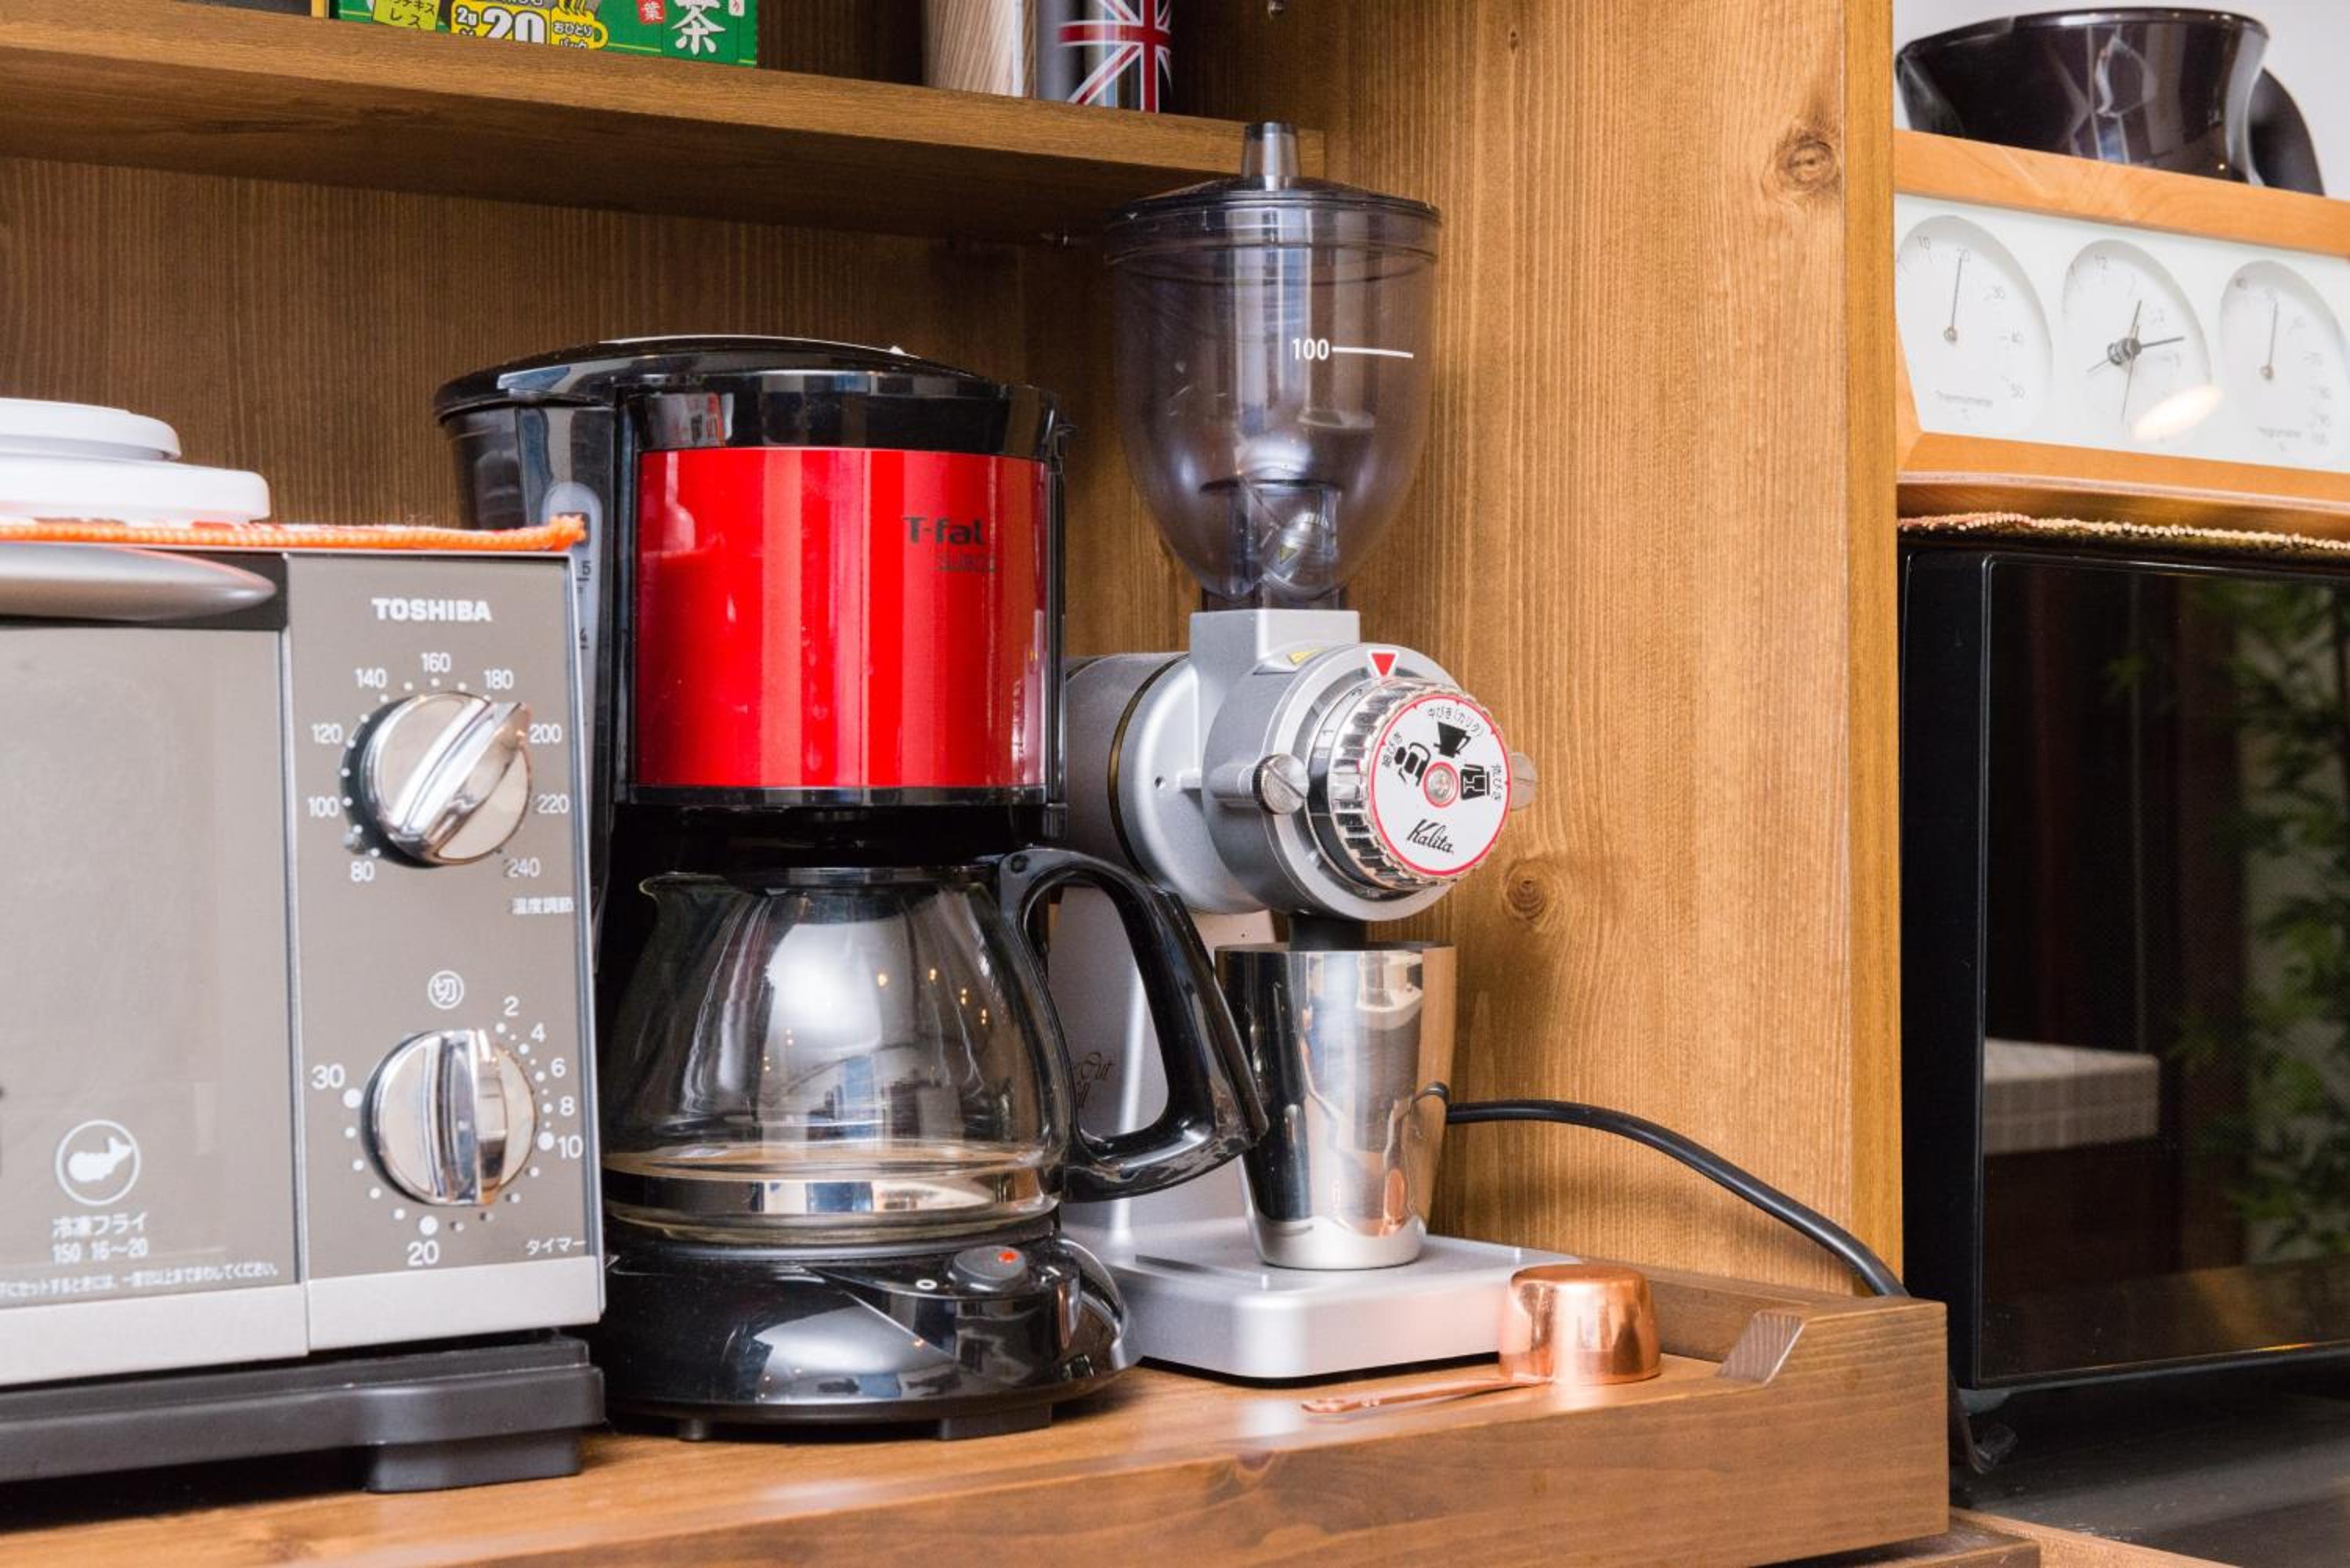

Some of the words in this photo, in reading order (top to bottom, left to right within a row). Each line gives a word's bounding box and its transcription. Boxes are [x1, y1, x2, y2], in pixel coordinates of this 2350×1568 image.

[553, 22, 592, 37] おひとり
[1292, 338, 1329, 361] 100
[902, 516, 984, 545] T-fal
[371, 598, 494, 623] TOSHIBA
[421, 652, 451, 674] 160
[355, 669, 387, 689] 140
[484, 670, 514, 689] 180
[312, 724, 342, 743] 120
[530, 724, 562, 743] 200
[308, 797, 339, 817] 100
[538, 794, 569, 815] 220
[1407, 818, 1455, 855] Kalita
[350, 862, 374, 883] 80
[508, 858, 541, 878] 240
[432, 976, 459, 1004] 切
[504, 995, 519, 1017] 2
[530, 1023, 547, 1042] 4
[311, 1064, 345, 1090] 30
[551, 1057, 566, 1078] 6
[560, 1097, 575, 1117] 8
[557, 1134, 583, 1160] 10
[407, 1240, 439, 1266] 20
[526, 1237, 587, 1255] タイマー
